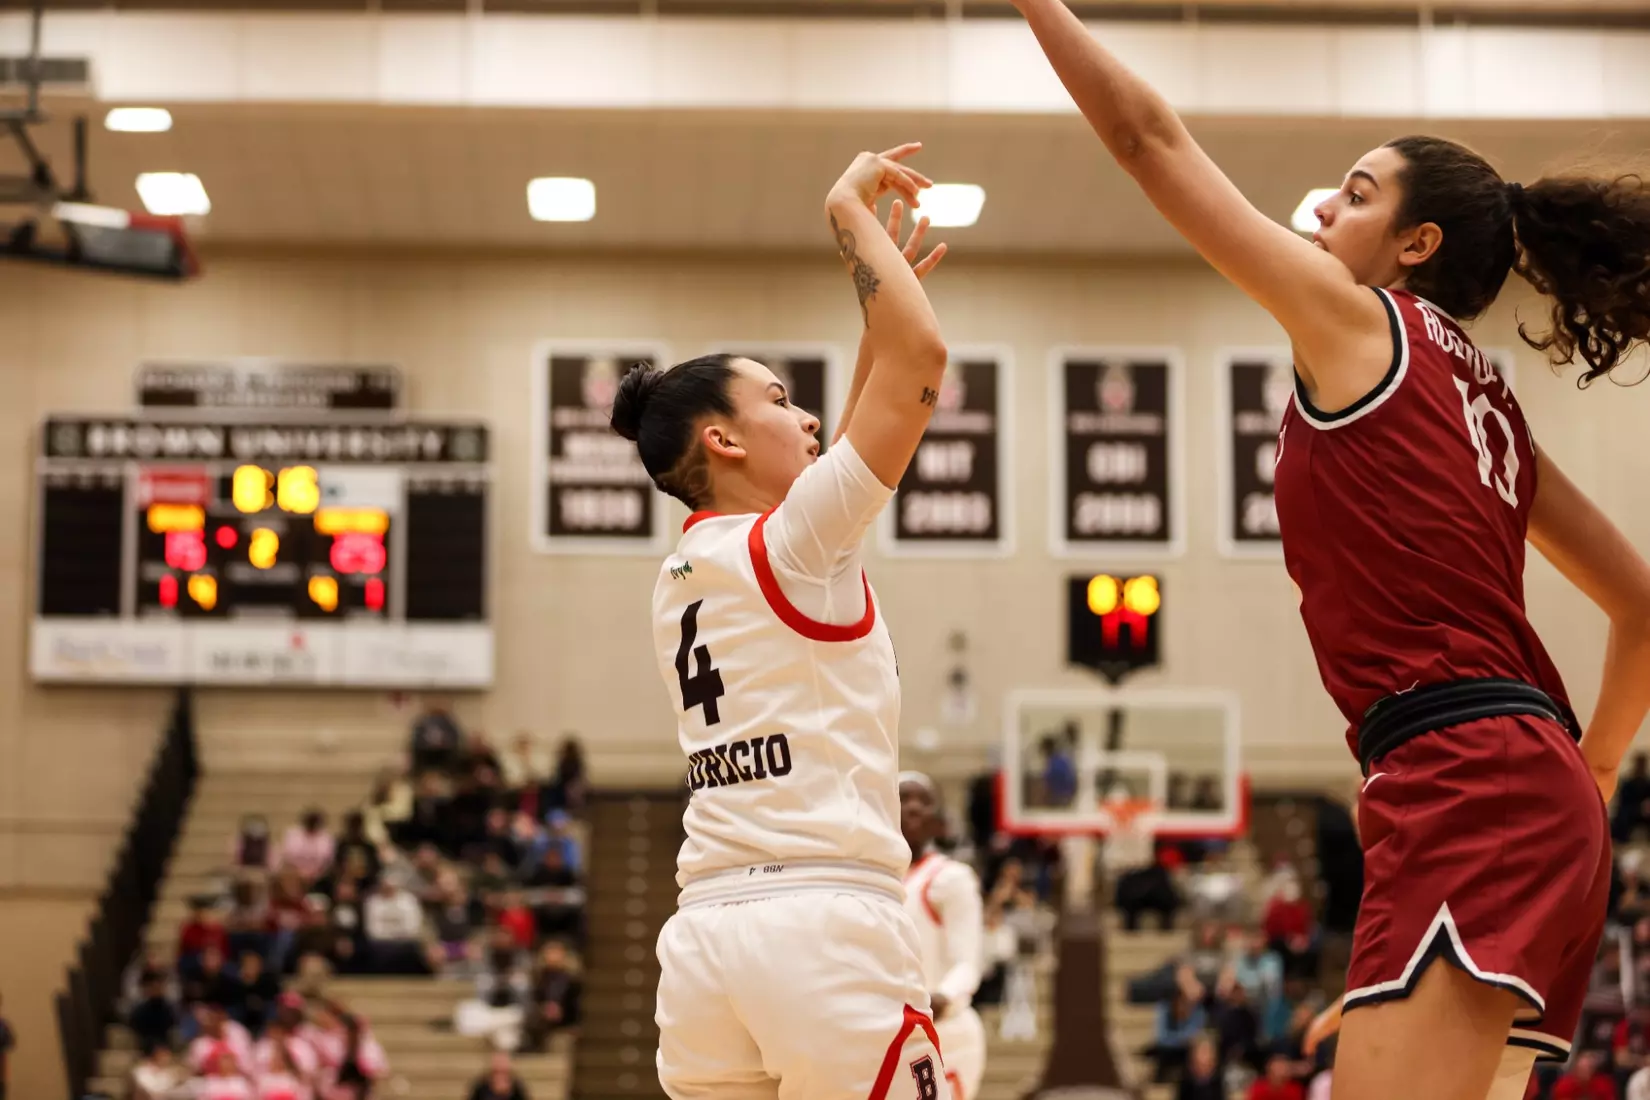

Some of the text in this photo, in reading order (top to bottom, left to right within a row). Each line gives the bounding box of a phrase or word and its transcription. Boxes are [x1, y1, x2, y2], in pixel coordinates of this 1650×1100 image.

[88, 425, 443, 459] BROWN UNIVERSITY
[675, 599, 724, 726] 4
[685, 733, 792, 791] URICIO
[910, 1054, 938, 1100] B
